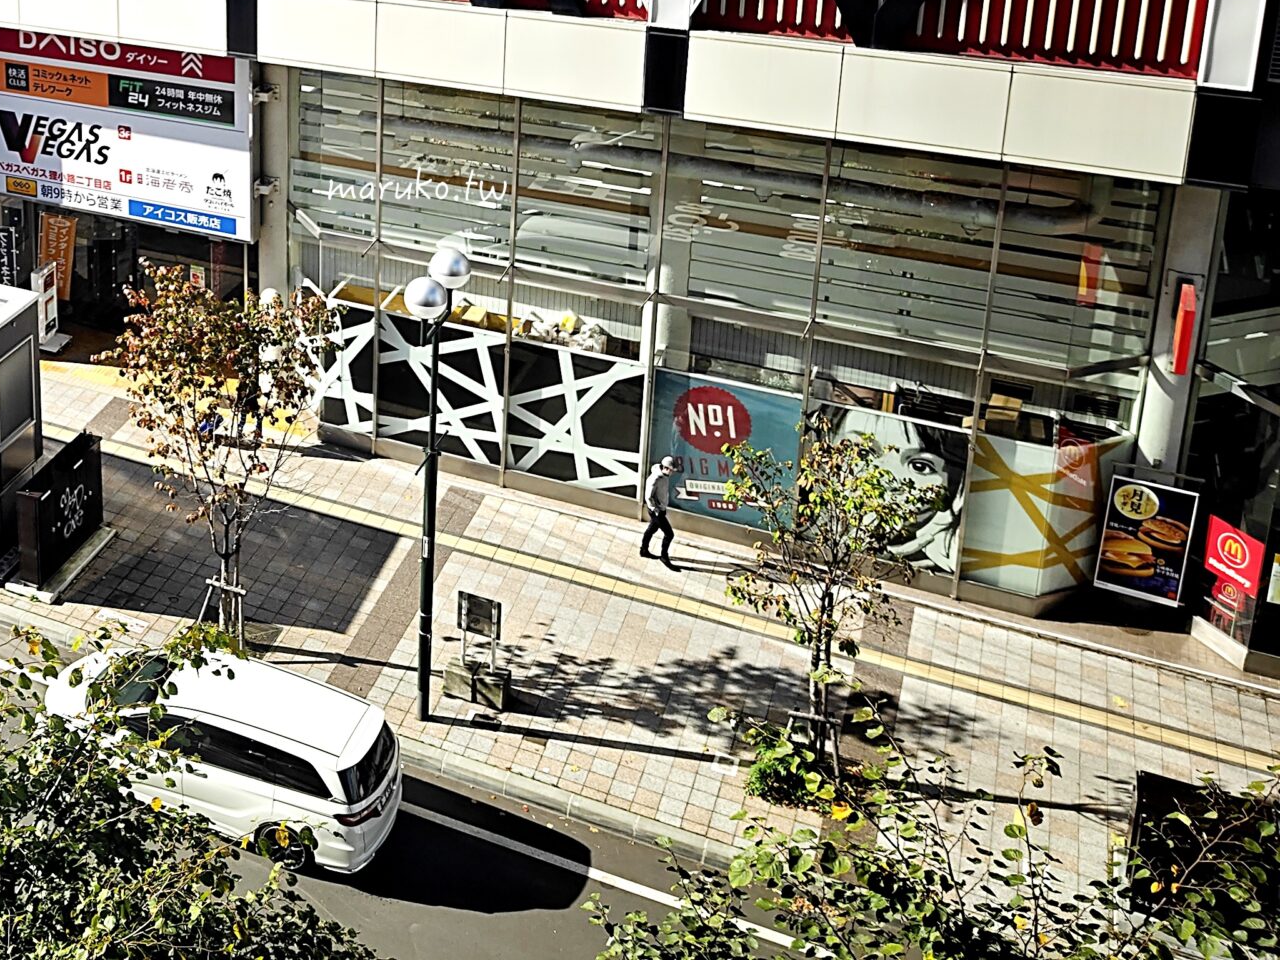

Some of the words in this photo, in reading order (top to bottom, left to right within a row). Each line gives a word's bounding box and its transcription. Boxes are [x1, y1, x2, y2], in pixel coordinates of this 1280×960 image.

[18, 30, 121, 61] DAISO
[125, 51, 169, 66] ダイソー
[8, 67, 26, 80] 快活
[8, 78, 27, 87] CLUB
[32, 82, 73, 97] テレワーク
[127, 92, 150, 108] 24
[155, 86, 184, 100] 24時間
[19, 134, 111, 165] VEGAS
[40, 183, 123, 212] 朝9時から営業
[142, 204, 221, 230] アイコス販売店
